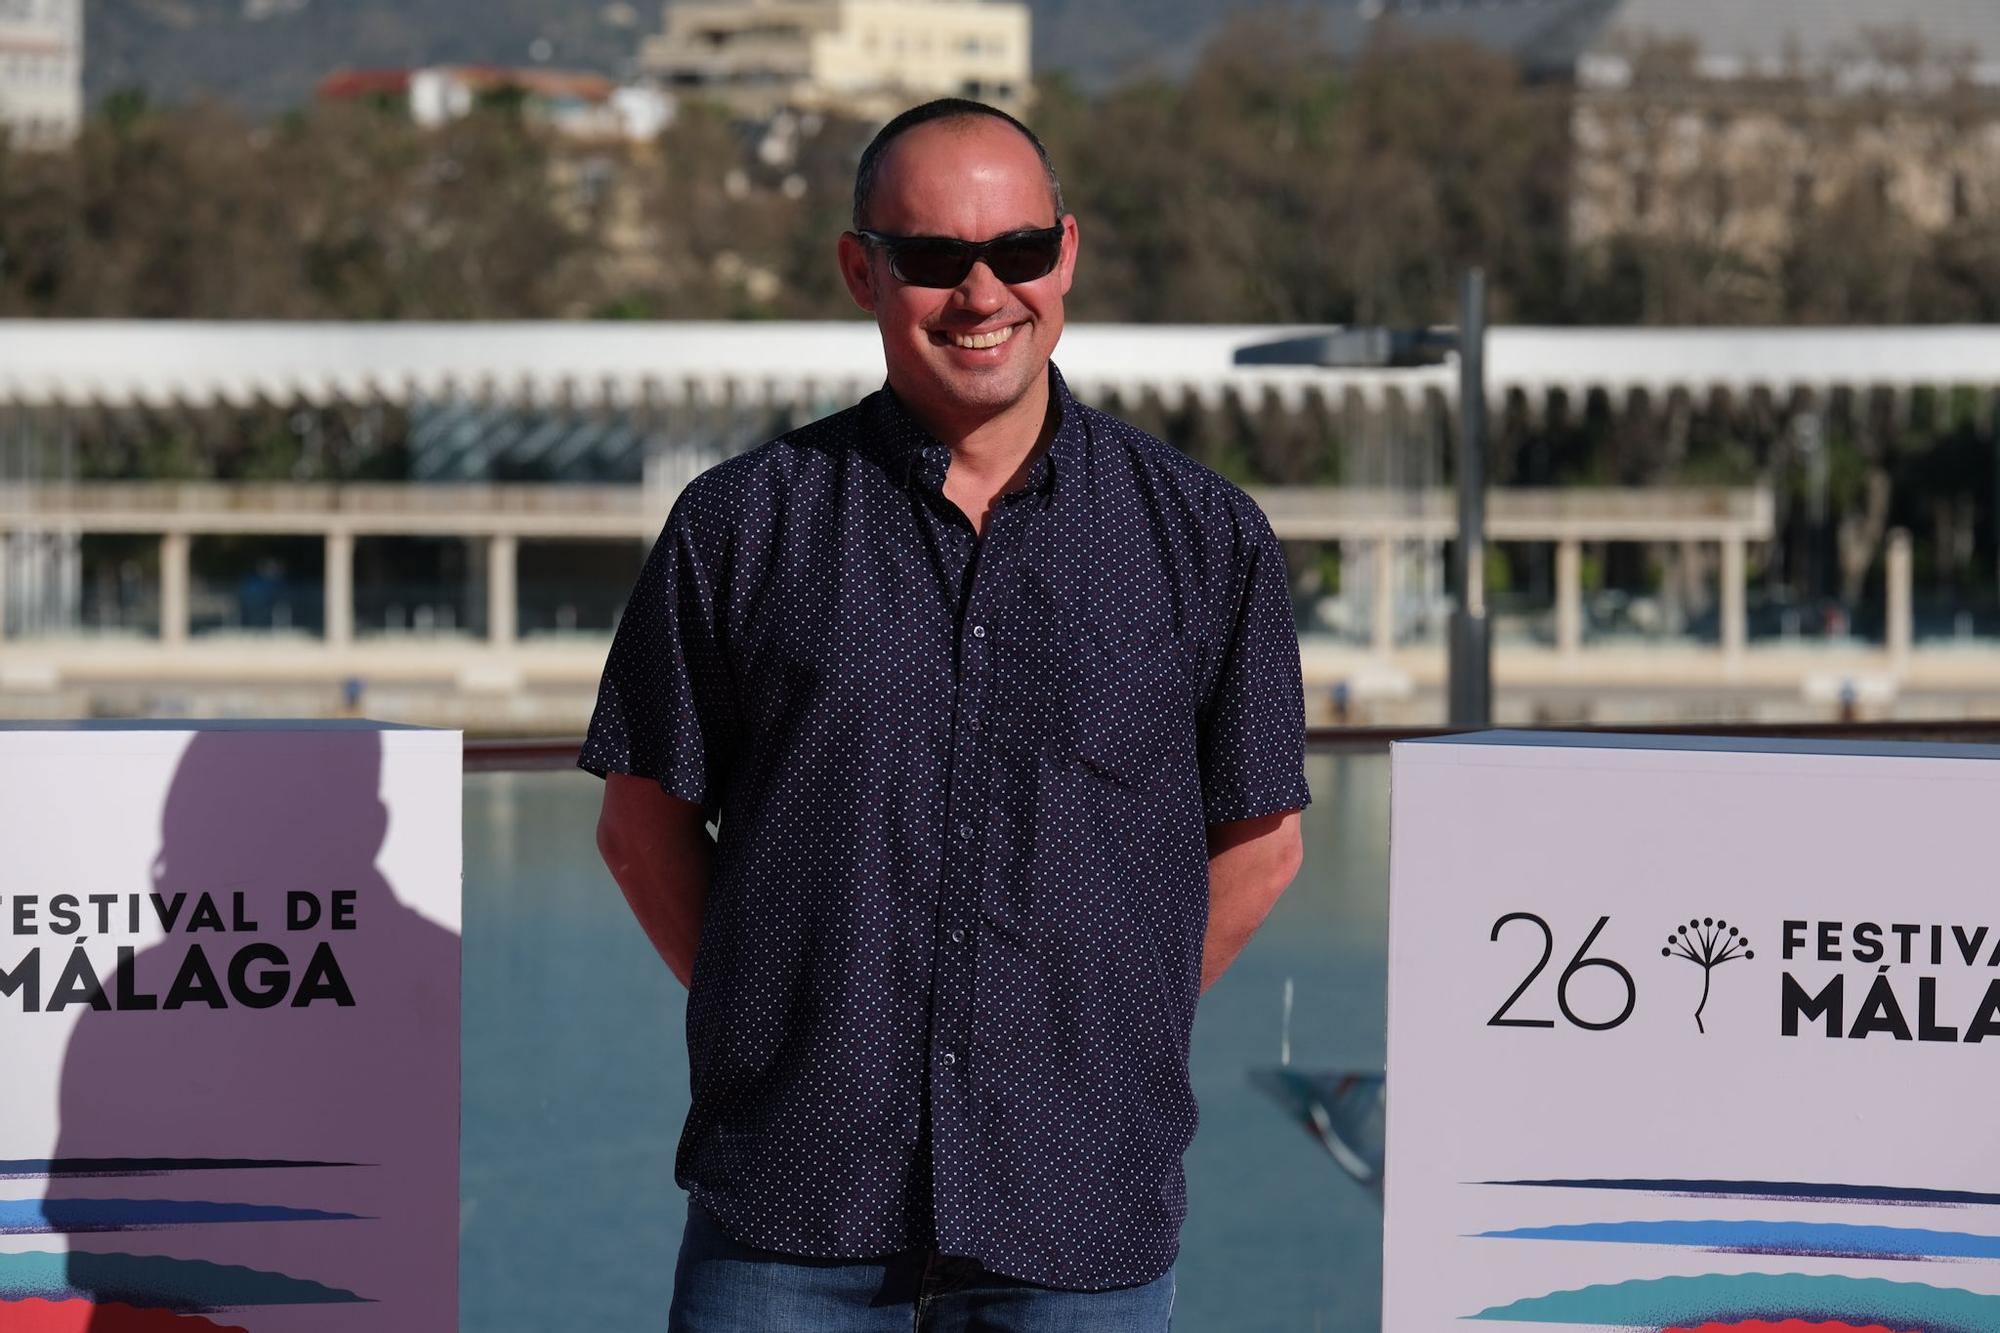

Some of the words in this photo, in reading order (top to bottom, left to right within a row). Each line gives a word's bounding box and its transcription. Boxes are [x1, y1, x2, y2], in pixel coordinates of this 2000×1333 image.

[0, 890, 258, 935] ESTIVAL
[286, 890, 357, 932] DE
[0, 936, 357, 1013] MÁLAGA
[1486, 912, 1636, 1031] 26
